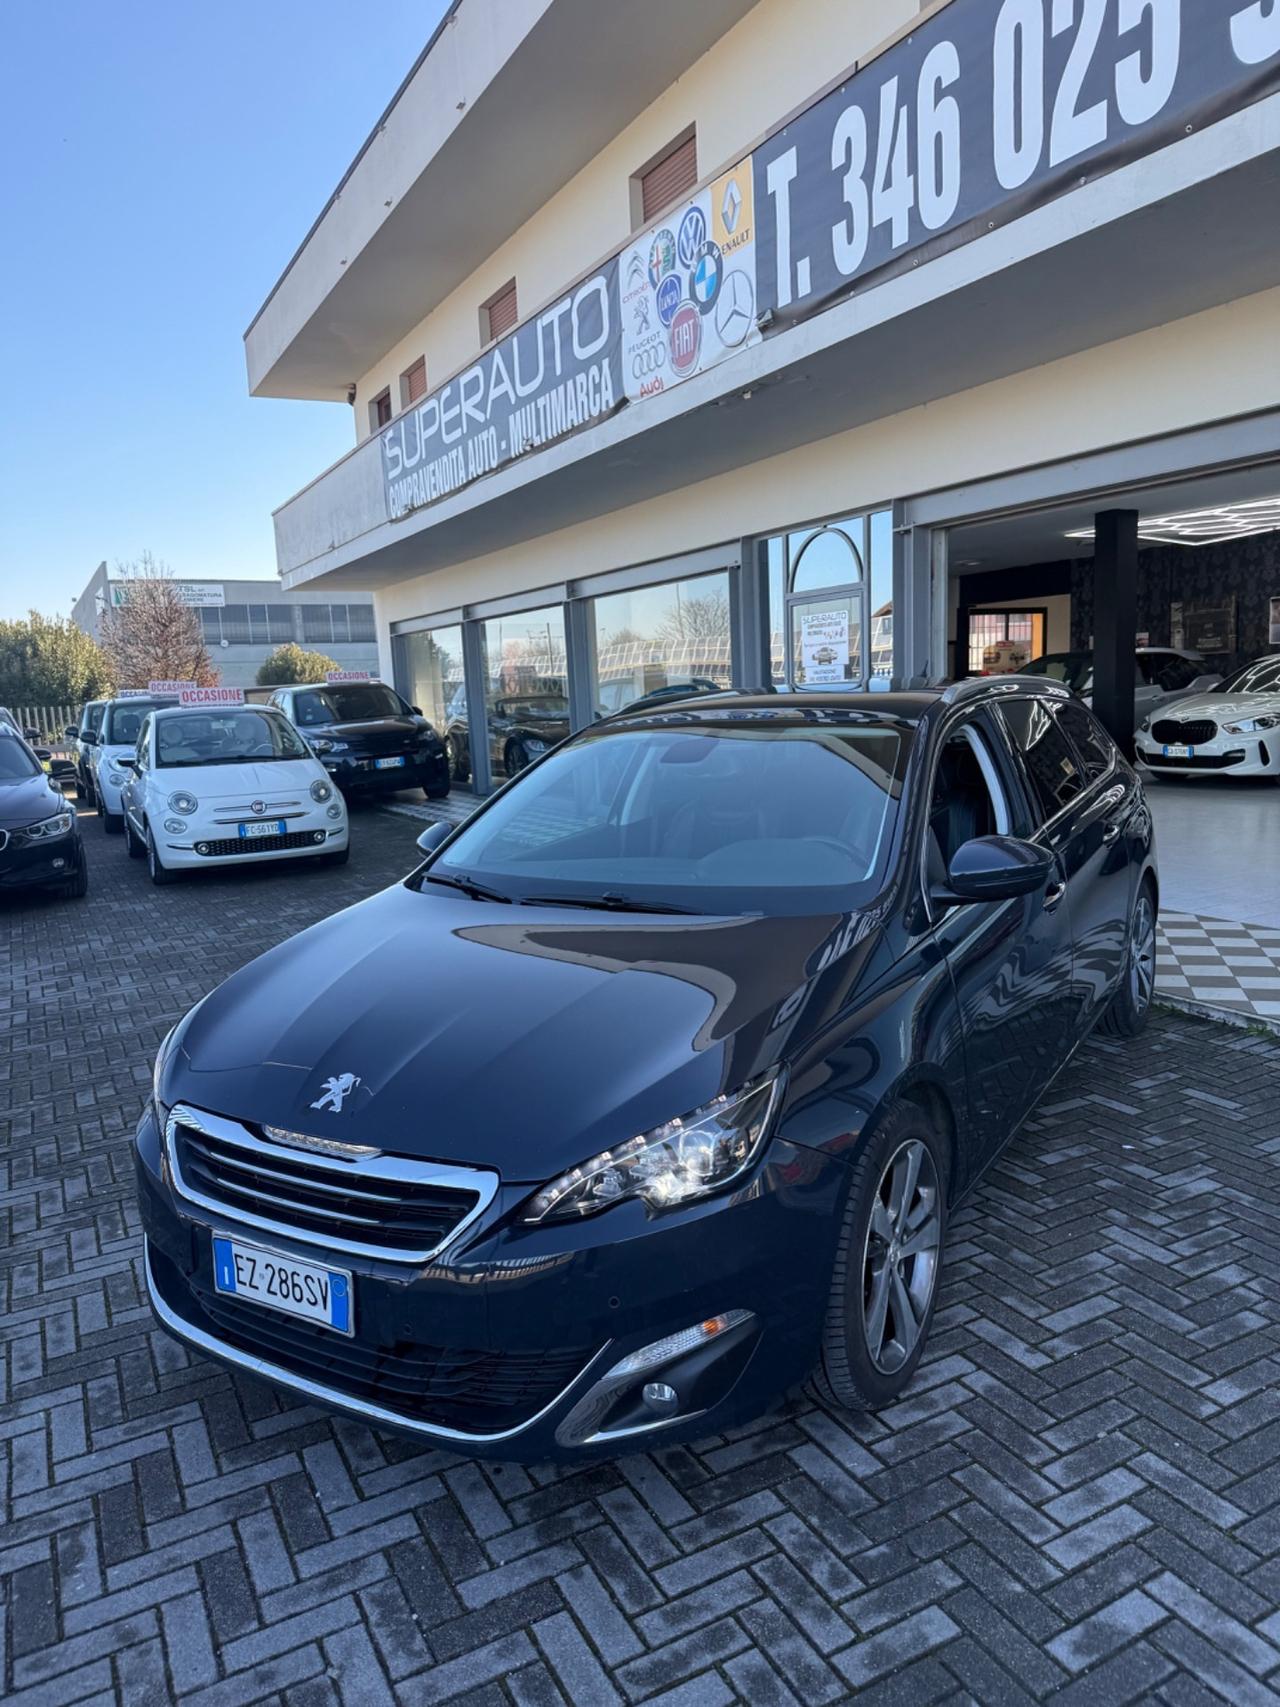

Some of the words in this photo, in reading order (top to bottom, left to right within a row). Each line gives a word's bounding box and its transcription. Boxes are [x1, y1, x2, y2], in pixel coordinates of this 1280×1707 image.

[766, 145, 812, 309] T.
[831, 40, 961, 276] 346
[993, 0, 1181, 190] 025
[721, 228, 750, 256] ENAULT
[628, 331, 661, 355] PEUGEOT
[674, 319, 695, 358] FIAT
[385, 275, 610, 481] SUPERAUTO
[640, 376, 664, 398] Audi
[388, 446, 465, 520] COMPRAVENDITA
[468, 425, 498, 481] AUTO
[509, 357, 614, 459] MULTIMARCA
[327, 671, 369, 681] OCCASIONE
[182, 688, 243, 703] OCCASIONE
